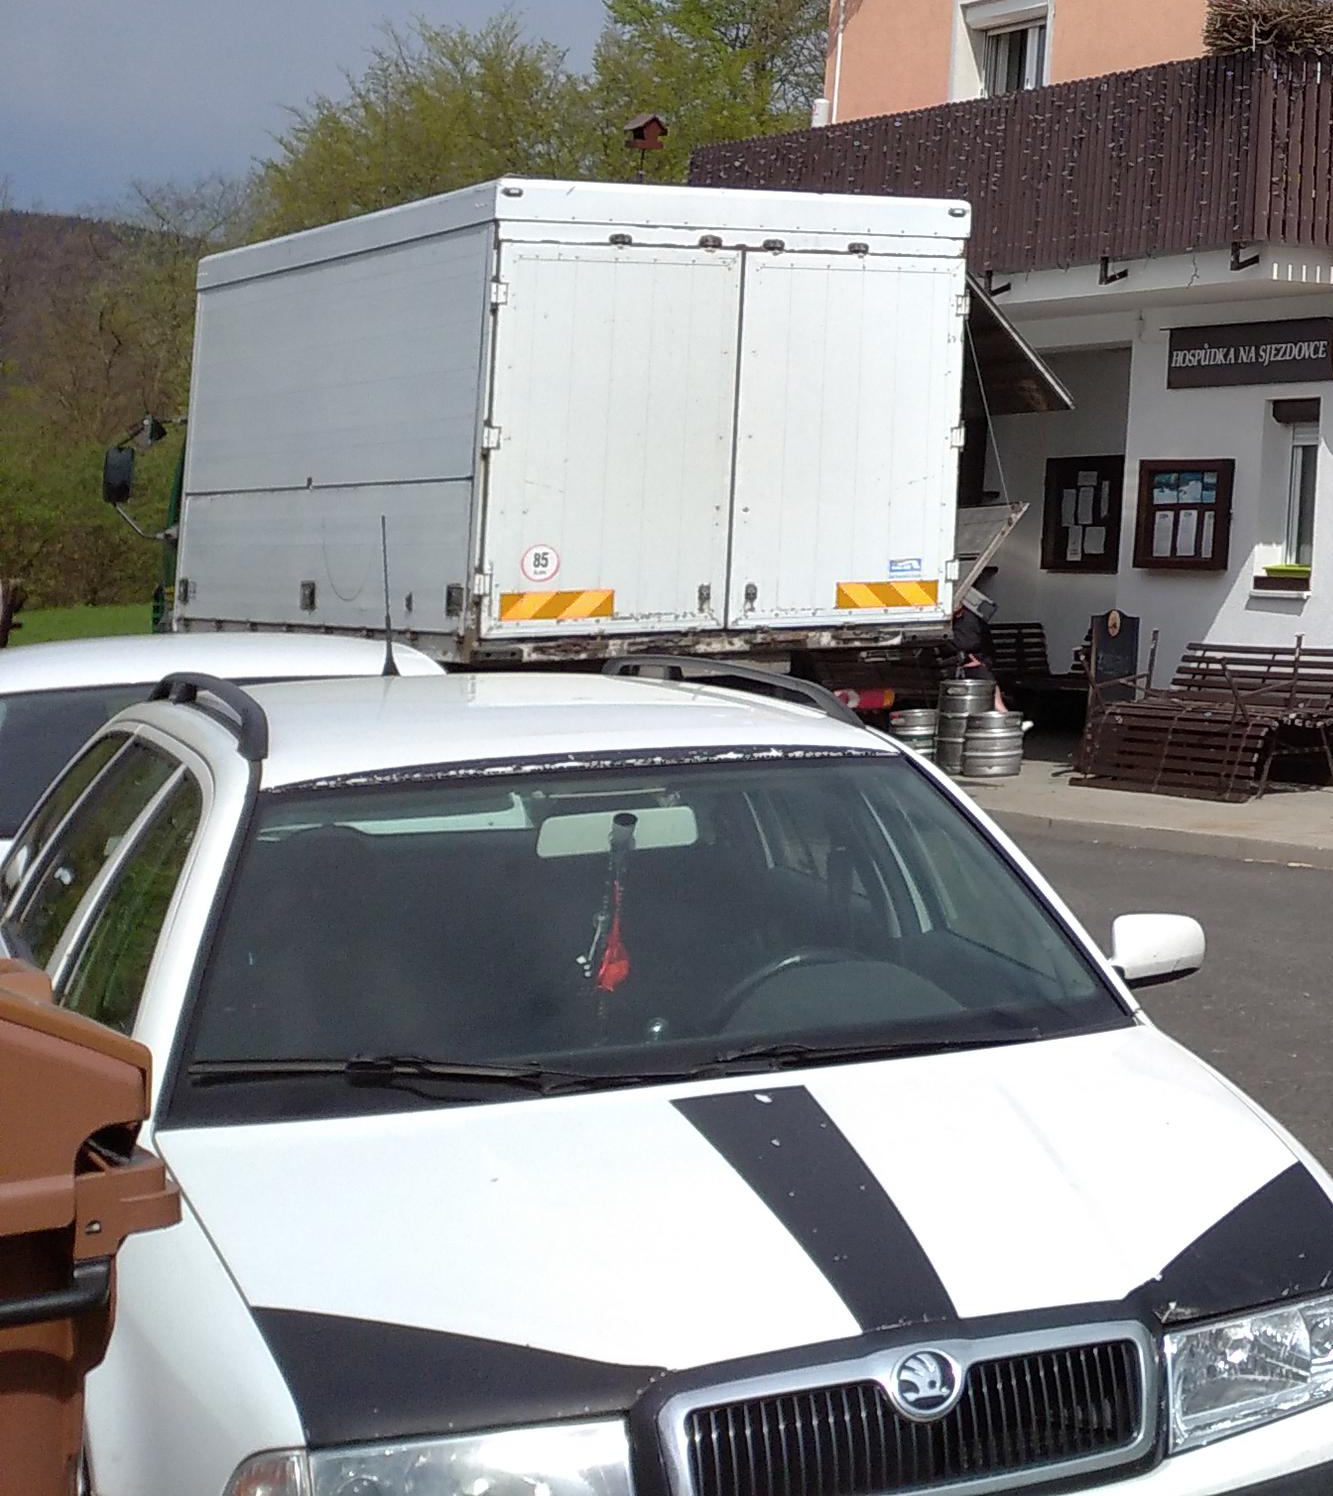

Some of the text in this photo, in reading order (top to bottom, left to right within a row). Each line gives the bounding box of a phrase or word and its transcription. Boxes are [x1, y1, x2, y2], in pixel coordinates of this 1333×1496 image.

[1171, 340, 1328, 367] HOSPŮDKA NA SJEZDOVCE
[533, 552, 549, 568] 85
